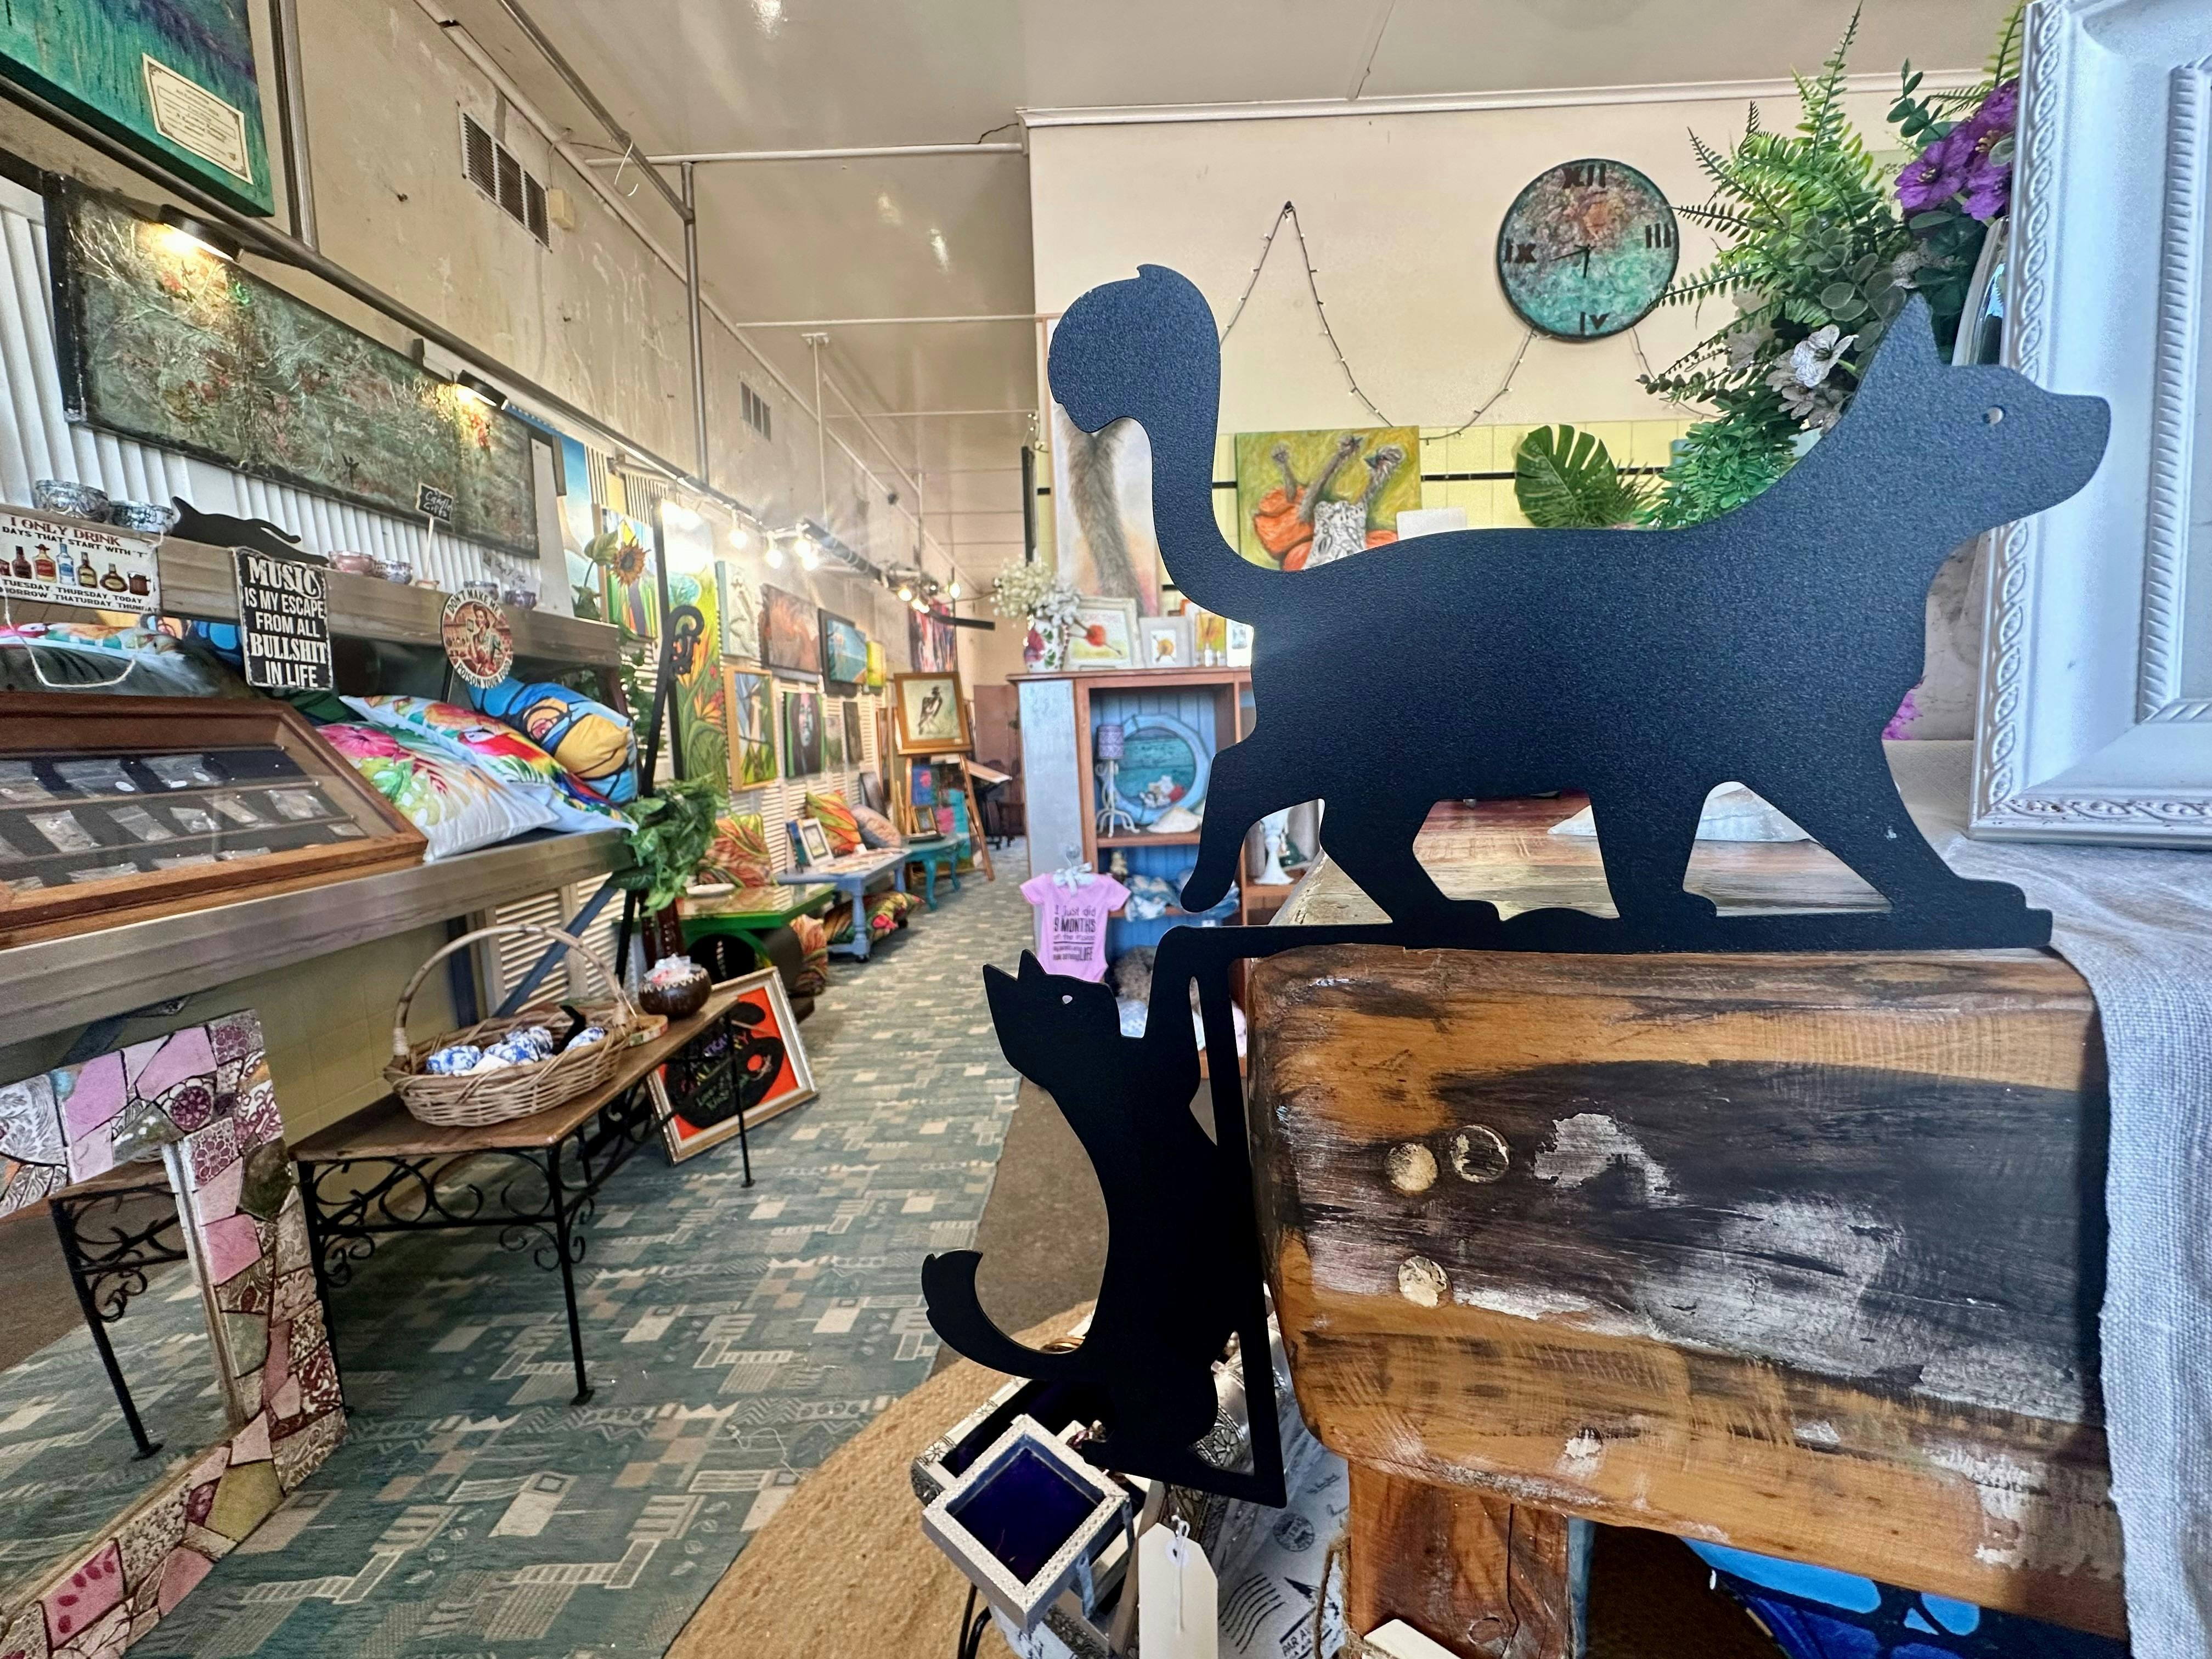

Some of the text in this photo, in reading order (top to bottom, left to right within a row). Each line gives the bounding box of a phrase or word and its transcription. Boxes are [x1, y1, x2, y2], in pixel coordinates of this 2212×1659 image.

[1562, 164, 1606, 188] XII
[1645, 223, 1672, 248] III
[1503, 239, 1537, 264] IX
[2, 526, 32, 537] DAYS
[35, 533, 65, 543] THAT
[68, 539, 101, 550] START
[104, 545, 131, 555] WITH
[10, 517, 121, 546] I ONLY DRINK
[247, 556, 321, 599] MUSIC
[112, 595, 142, 603] TODAY
[244, 586, 325, 619] IS MY ESCAPE
[467, 589, 489, 603] MAKE
[255, 611, 320, 637] FROM ALL
[249, 632, 327, 664] BULLSHIT
[265, 661, 318, 688] IN LIFE
[456, 662, 481, 685] POISON
[1082, 905, 1096, 917] did
[1054, 917, 1096, 933] 9 MONTHS
